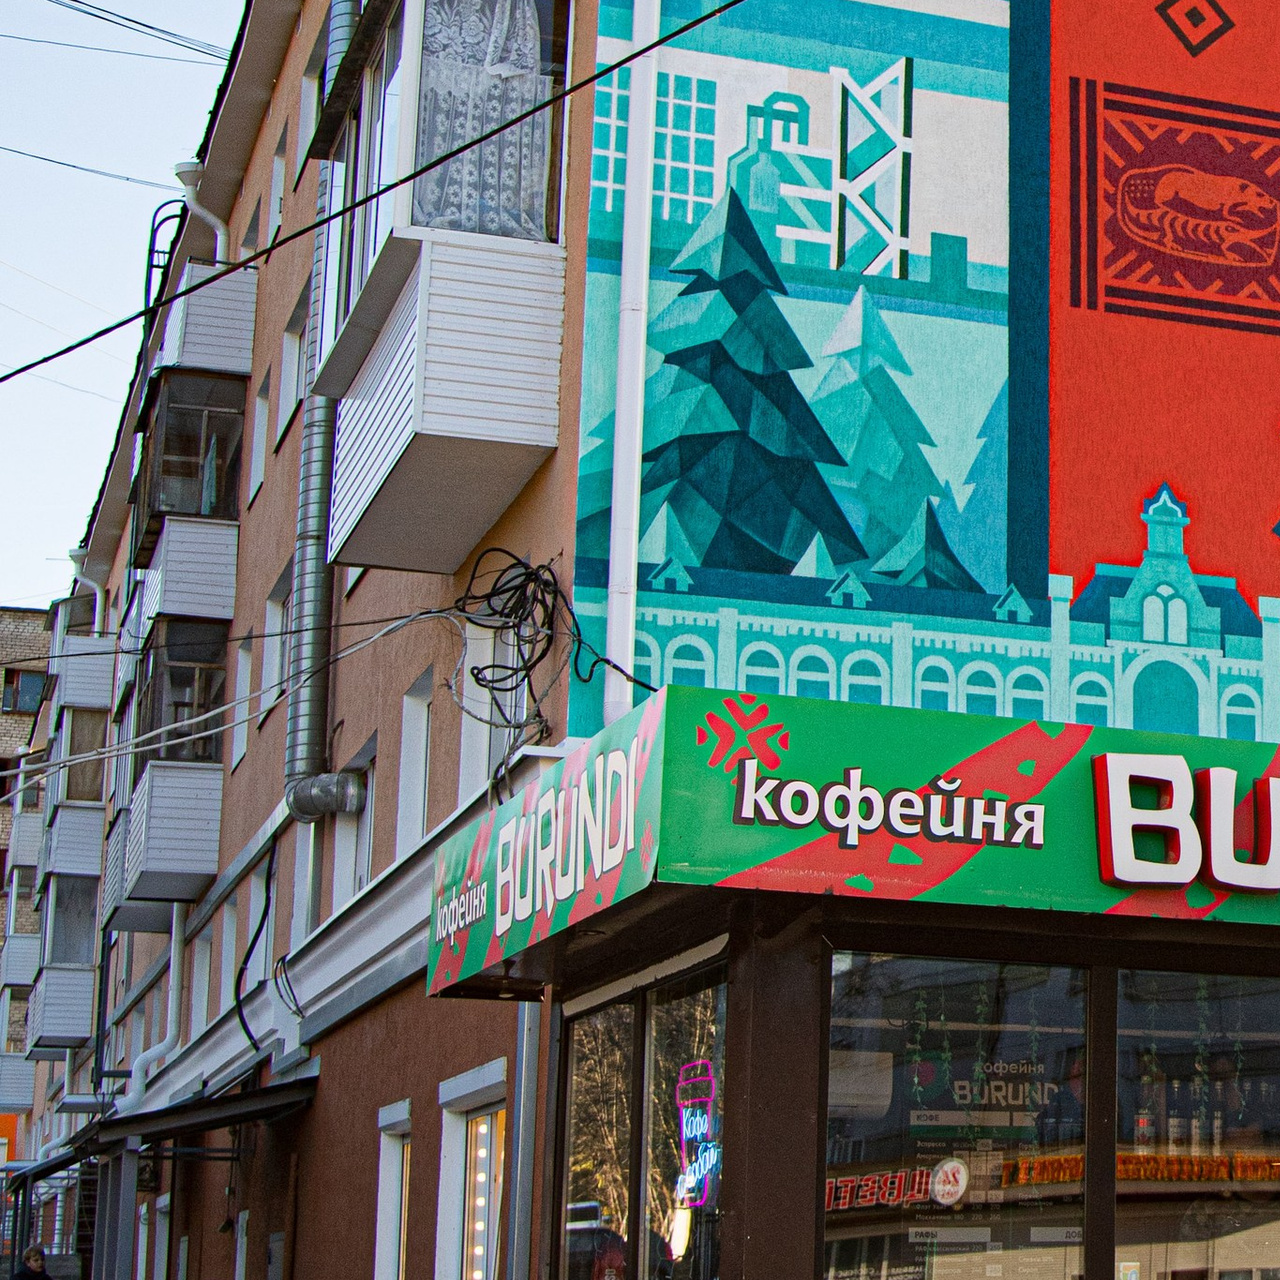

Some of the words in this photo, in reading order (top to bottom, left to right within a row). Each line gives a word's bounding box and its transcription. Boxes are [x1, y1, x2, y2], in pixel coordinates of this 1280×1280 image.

[740, 758, 1046, 848] кофейня
[495, 734, 638, 937] BURUNDI
[435, 879, 488, 946] кофейня
[975, 1060, 1045, 1076] офейня
[954, 1080, 1059, 1106] BURUND
[683, 1108, 708, 1140] Кофе
[915, 1231, 937, 1239] РАФЫ
